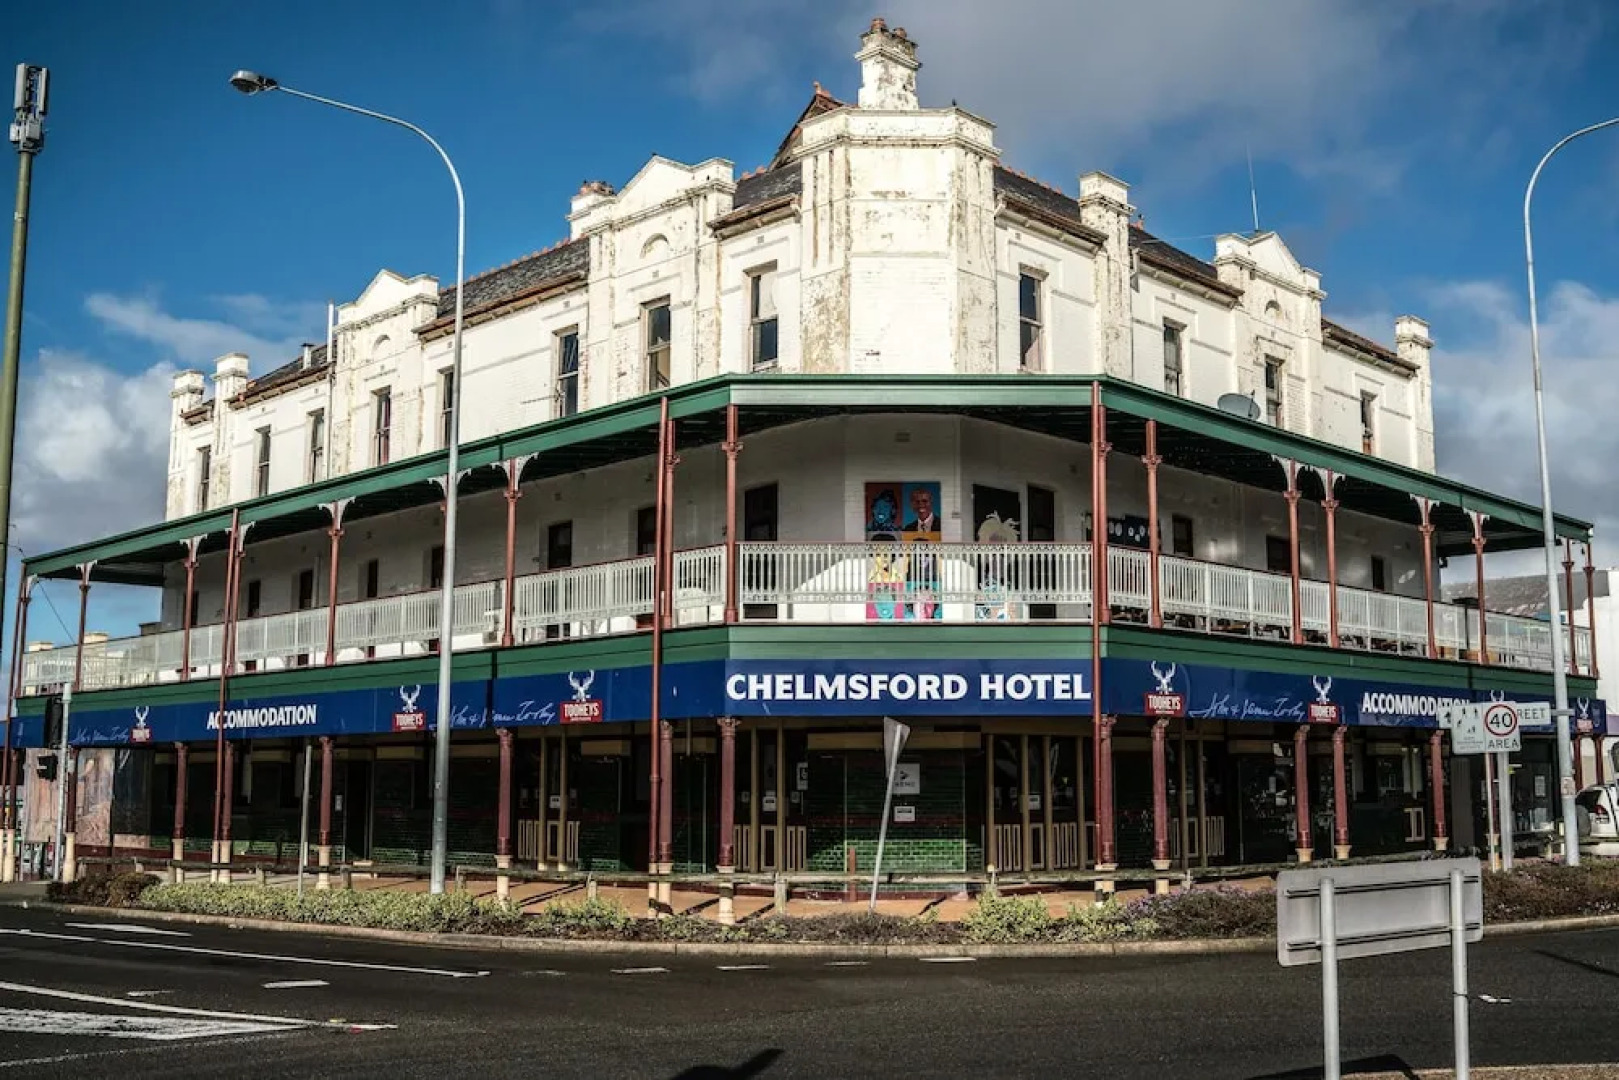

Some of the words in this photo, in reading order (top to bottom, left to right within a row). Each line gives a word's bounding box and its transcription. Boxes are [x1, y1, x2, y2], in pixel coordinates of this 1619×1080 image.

[726, 674, 968, 700] CHELMSFORD
[979, 674, 1092, 700] HOTEL
[206, 704, 317, 730] ACCOMMODATION
[1490, 713, 1513, 728] 40
[1517, 708, 1545, 720] REET
[1487, 738, 1519, 750] AREA
